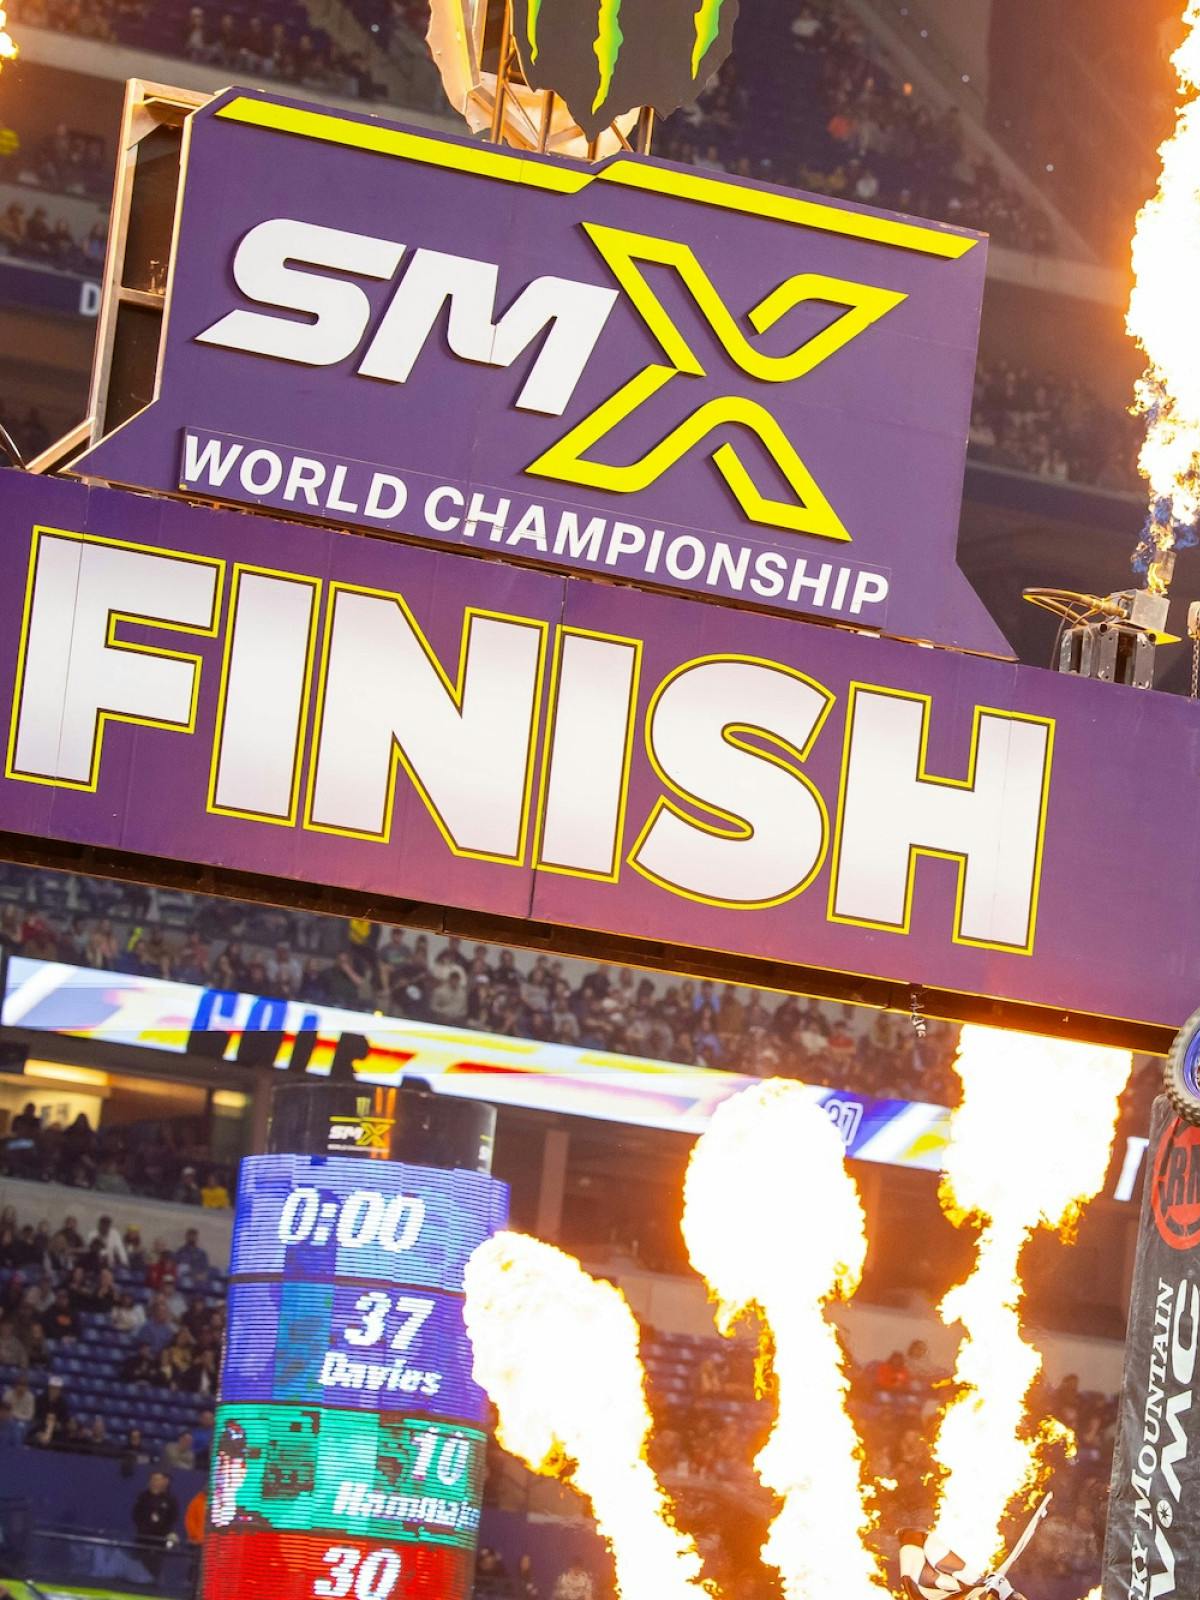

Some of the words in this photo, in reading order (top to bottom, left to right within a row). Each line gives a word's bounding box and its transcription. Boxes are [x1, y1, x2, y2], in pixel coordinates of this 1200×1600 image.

[195, 218, 909, 542] SMX
[181, 434, 409, 522] WORLD
[422, 485, 889, 616] CHAMPIONSHIP
[5, 525, 1056, 955] FINISH
[328, 1122, 392, 1147] SMX
[278, 1187, 426, 1252] 0:00
[344, 1292, 436, 1350] 37
[318, 1352, 443, 1396] Davies
[1131, 1277, 1175, 1530] MOUNTAIN
[411, 1426, 471, 1486] 10
[313, 1547, 402, 1600] 30
